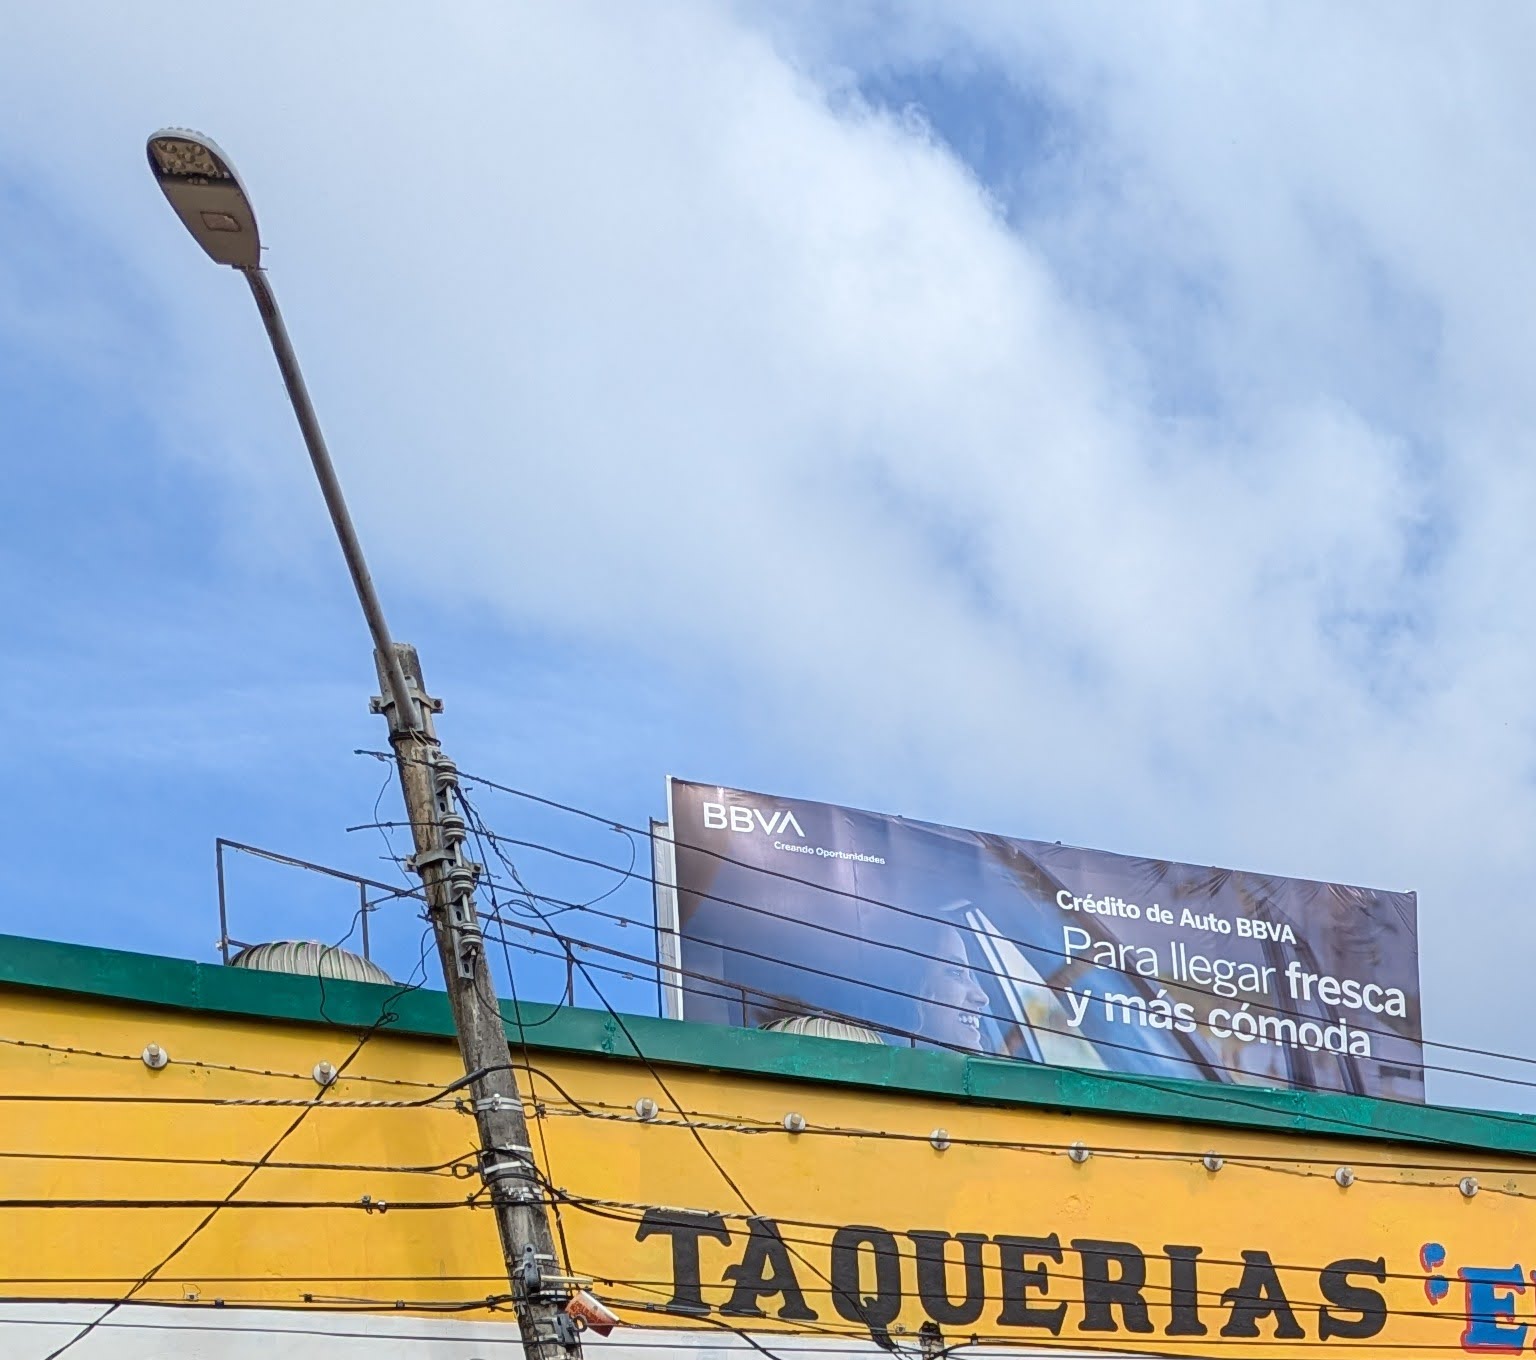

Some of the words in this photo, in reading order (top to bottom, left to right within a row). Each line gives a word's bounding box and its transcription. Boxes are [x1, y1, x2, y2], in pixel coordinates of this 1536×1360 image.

[703, 802, 805, 837] BBVA
[774, 841, 814, 855] Creando
[816, 847, 885, 864] Oportunidades
[1056, 890, 1141, 919] Crédito
[1146, 904, 1174, 925] de
[1180, 908, 1231, 934] Auto
[1236, 917, 1297, 945] BBVA
[1063, 925, 1159, 977] Para
[1170, 941, 1276, 998] llegar
[1285, 961, 1407, 1018] fresca
[1065, 986, 1090, 1028] y
[1104, 989, 1197, 1033] más
[1209, 1003, 1371, 1060] cómoda
[636, 1208, 1388, 1350] TAQUERIAS
